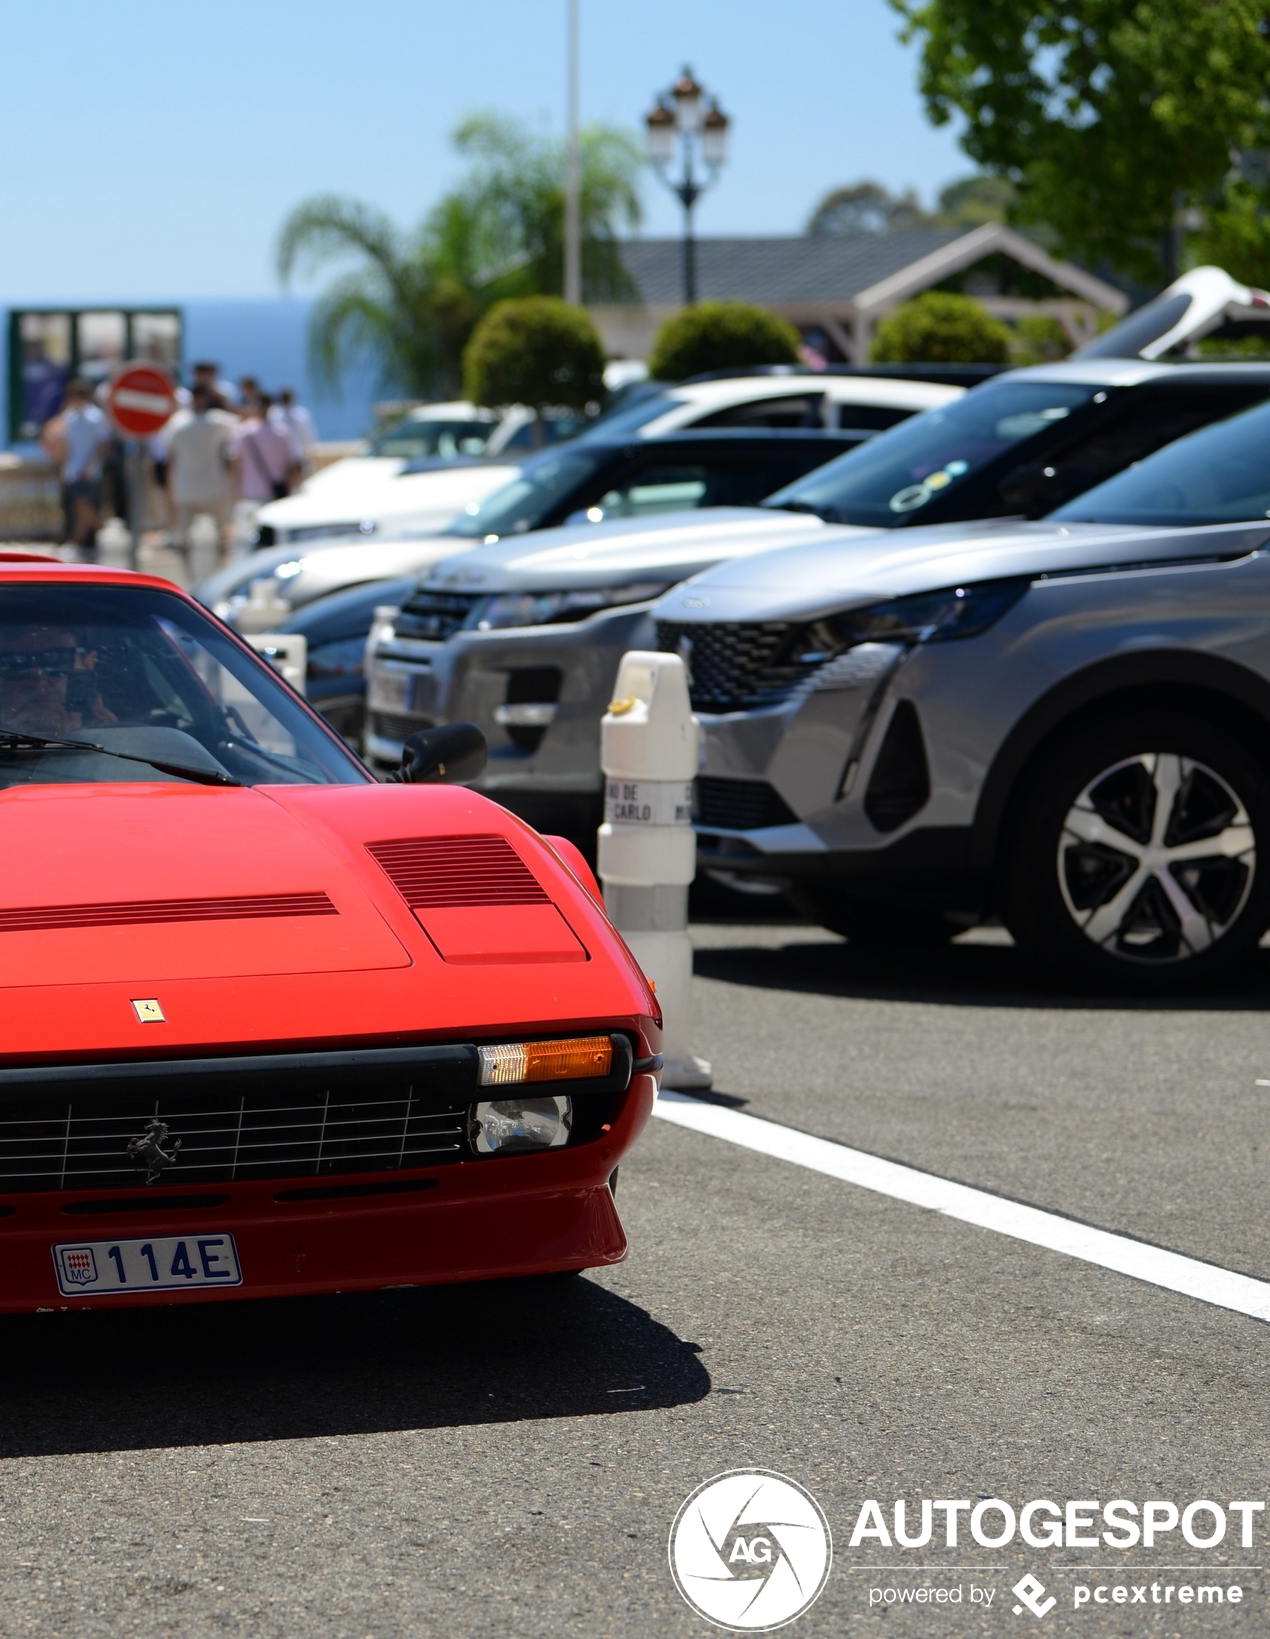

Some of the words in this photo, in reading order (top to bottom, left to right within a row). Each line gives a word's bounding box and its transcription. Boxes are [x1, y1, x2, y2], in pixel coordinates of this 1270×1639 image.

[623, 784, 638, 801] DE
[108, 1239, 231, 1283] 114E
[70, 1269, 91, 1281] MC
